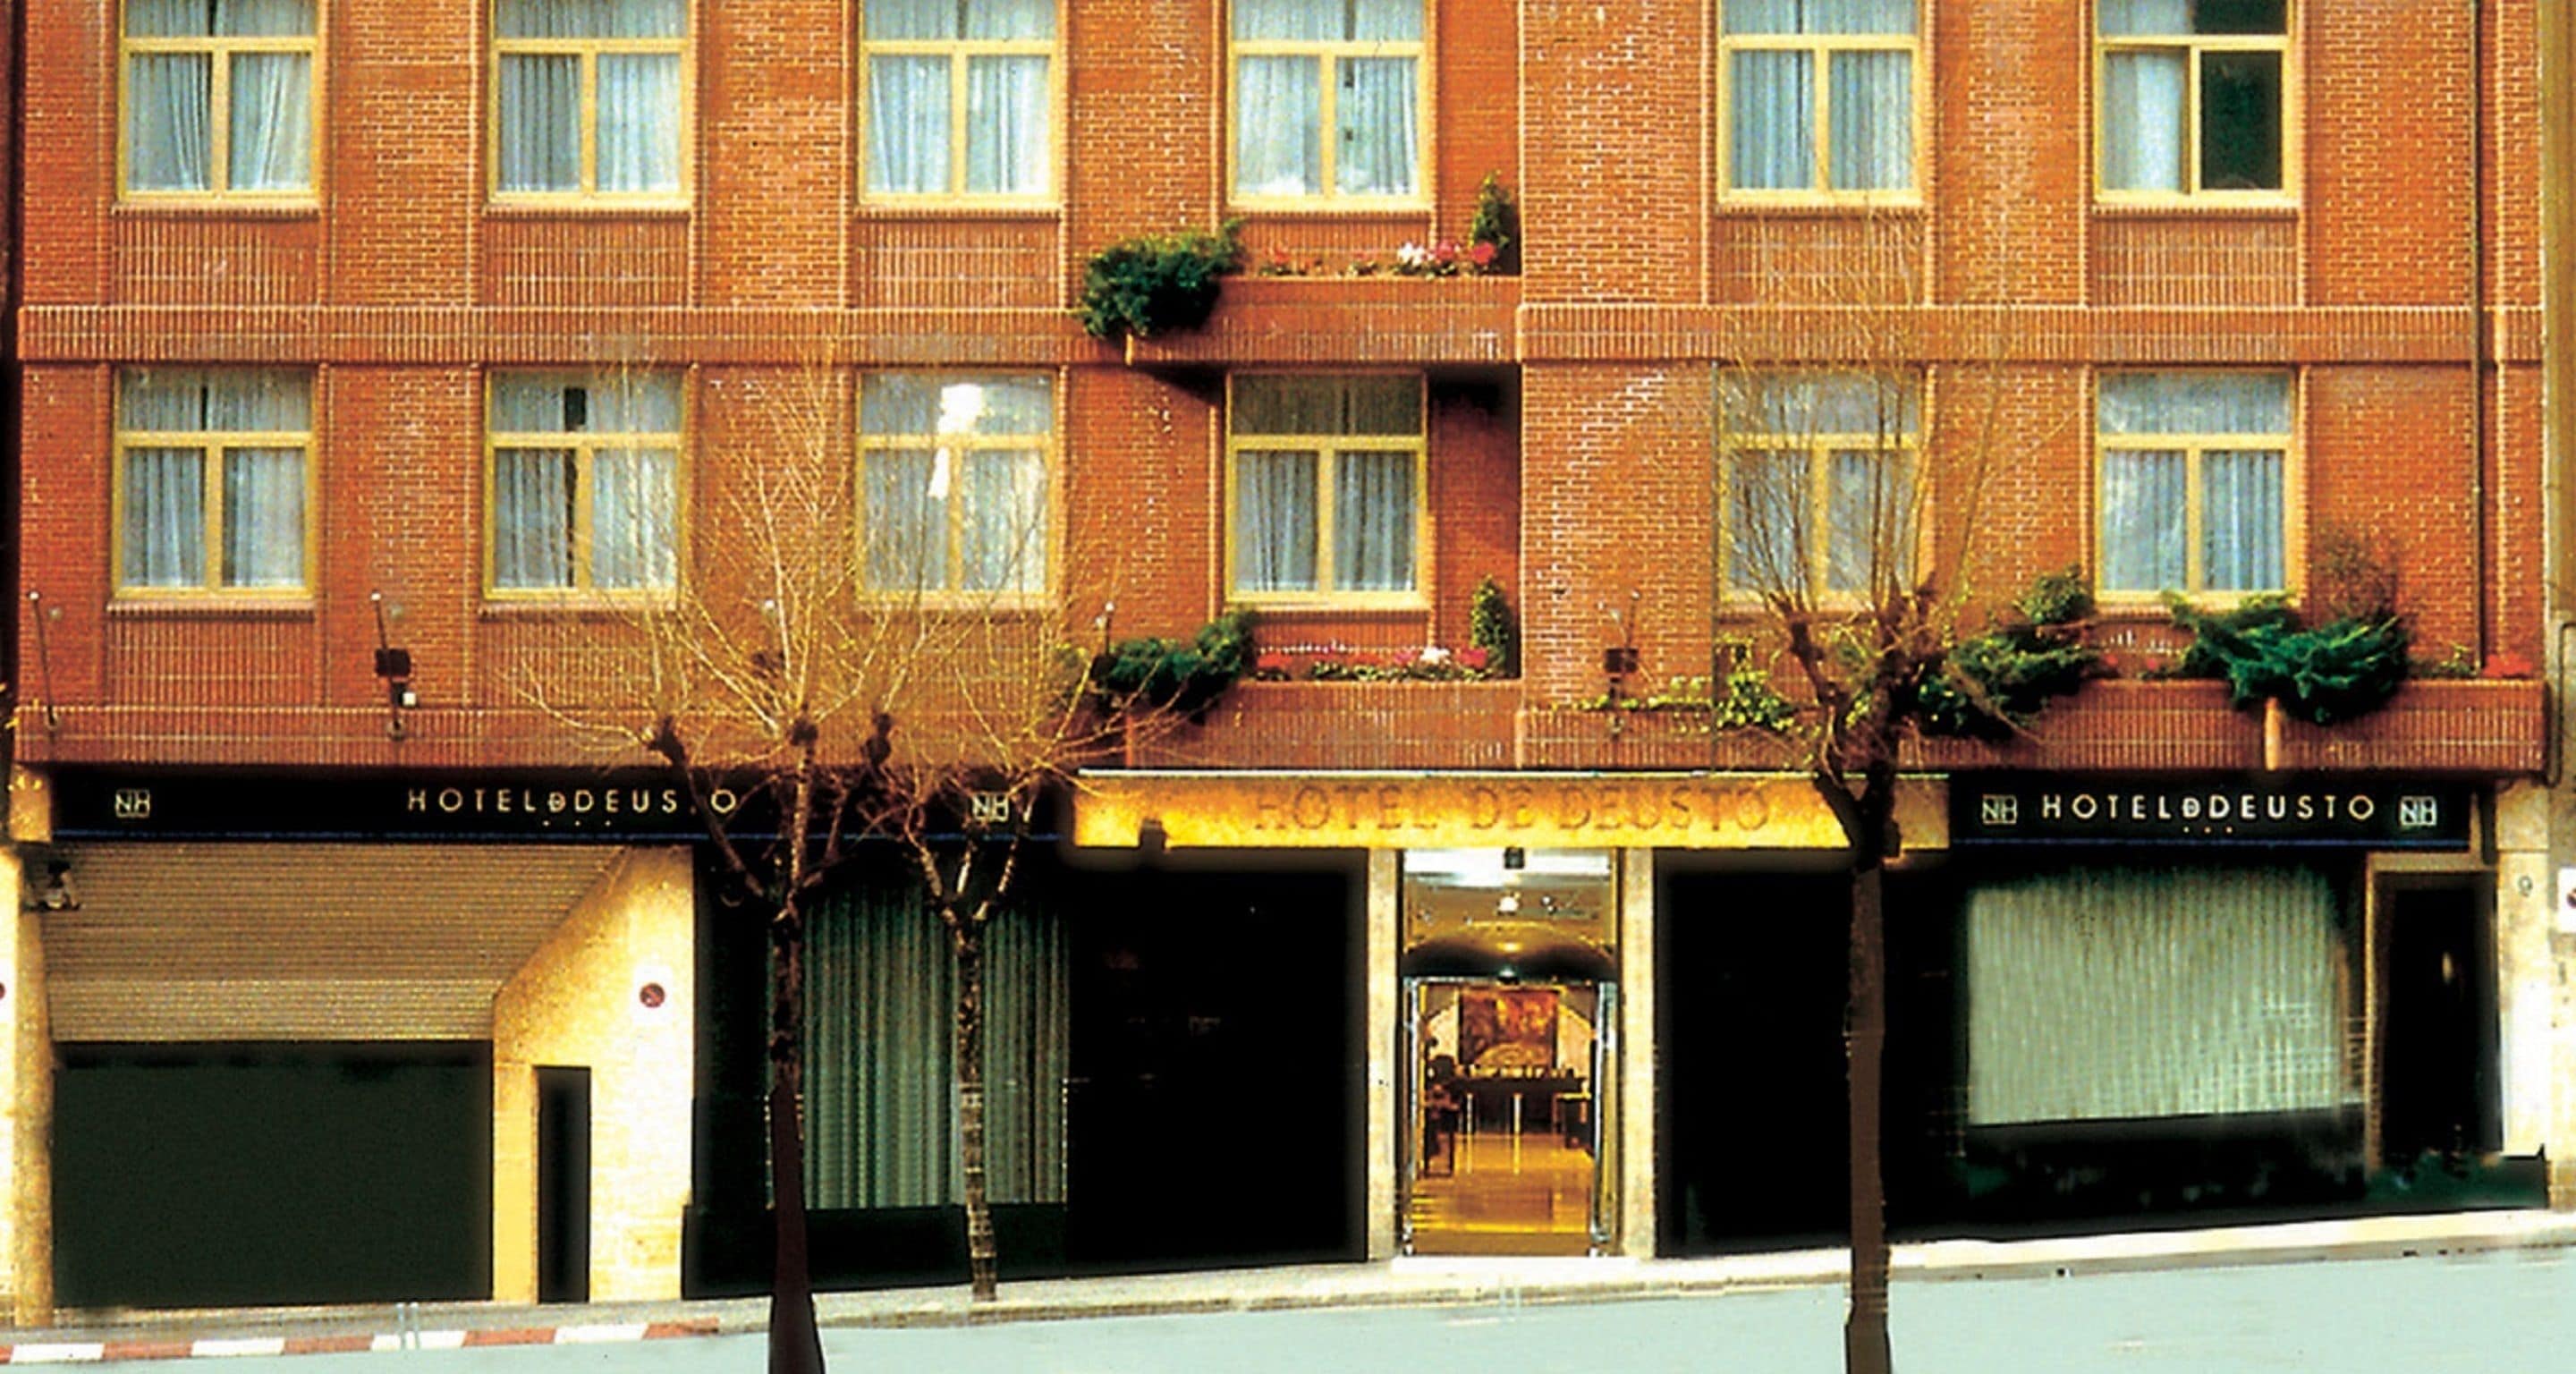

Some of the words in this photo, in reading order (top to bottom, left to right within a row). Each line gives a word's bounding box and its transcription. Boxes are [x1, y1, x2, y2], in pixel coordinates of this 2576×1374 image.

[115, 789, 150, 818] NH
[408, 788, 537, 813] HOTEL
[574, 788, 737, 814] DEUSO
[971, 792, 1009, 823] NH
[1255, 785, 1437, 830] HOTEL
[1559, 785, 1769, 831] DEUSTO
[1981, 793, 2018, 825] NH
[2042, 793, 2173, 819] HOTEL
[2207, 793, 2376, 820] DEUSTO
[2398, 795, 2437, 827] NH
